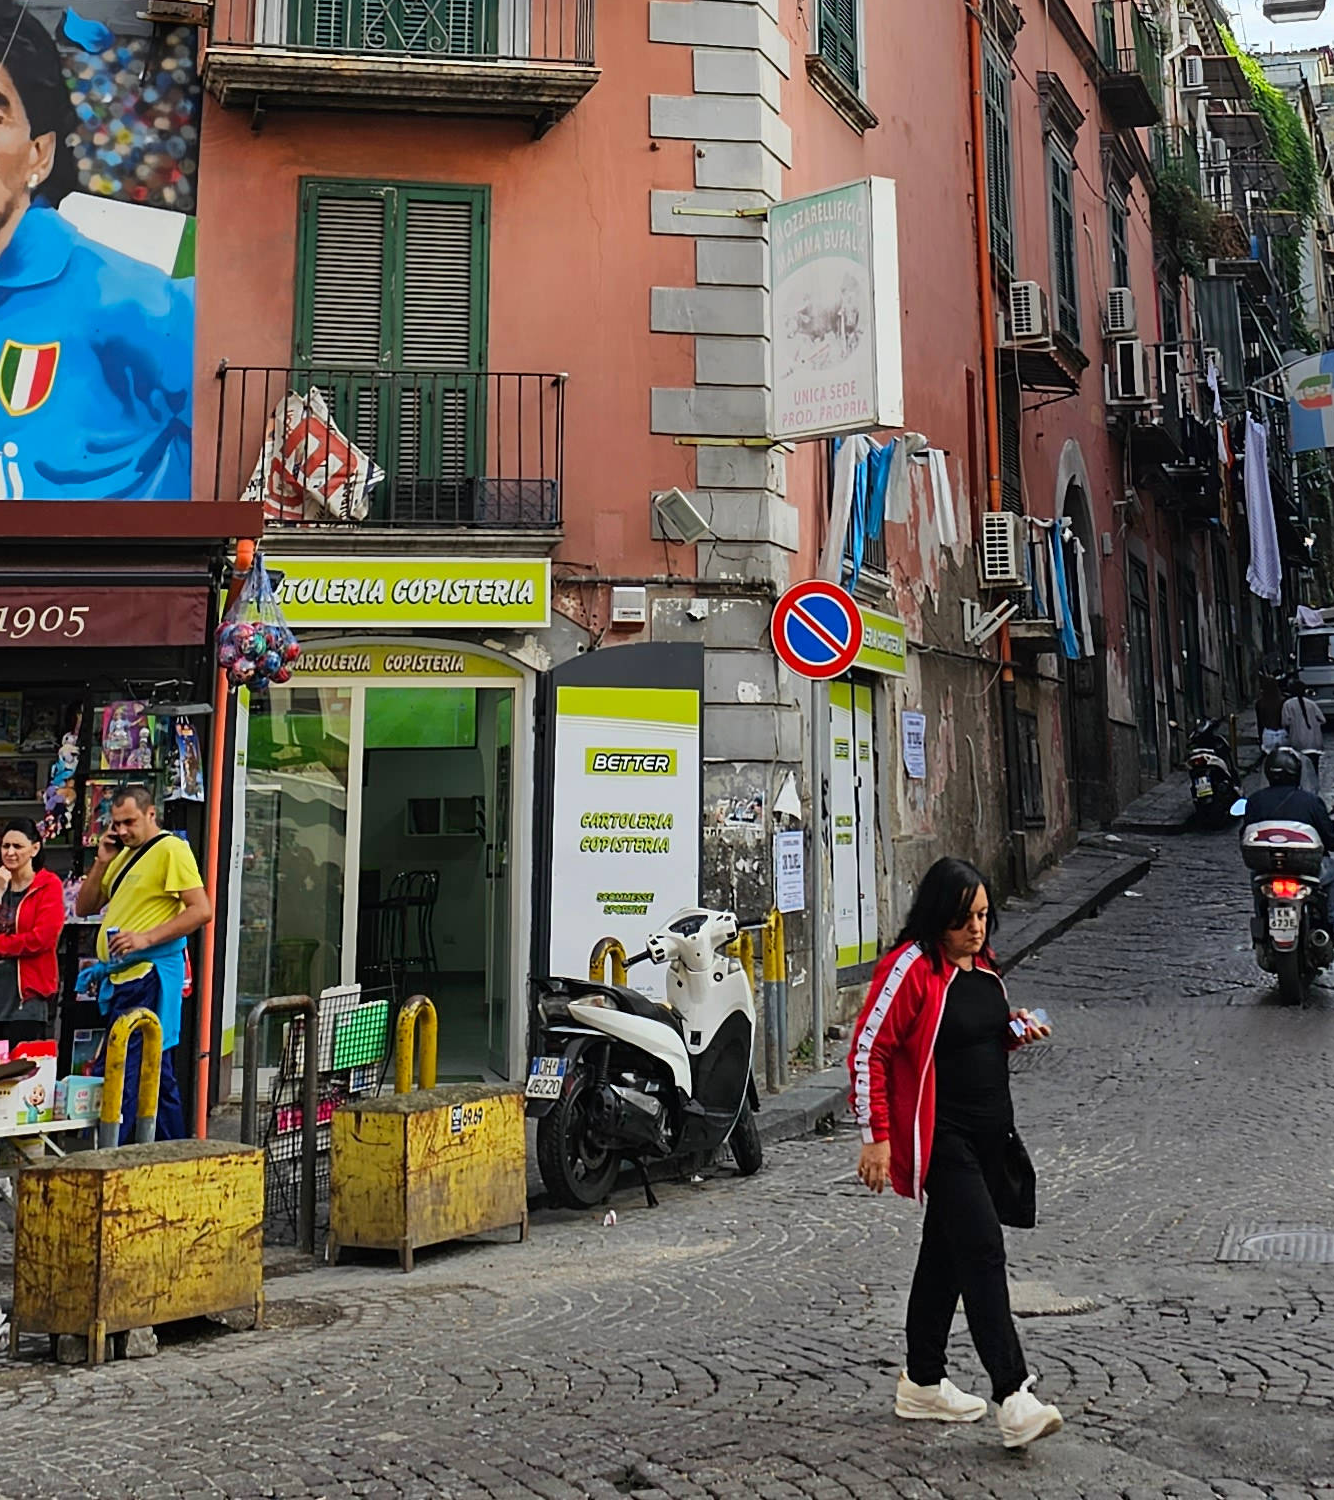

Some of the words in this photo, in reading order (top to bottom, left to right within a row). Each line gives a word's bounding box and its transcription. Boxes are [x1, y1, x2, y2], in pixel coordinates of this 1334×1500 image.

[776, 238, 820, 273] MAMMA
[794, 389, 827, 406] UNICA
[830, 379, 856, 400] SEDE
[782, 409, 817, 427] PROD.
[820, 400, 868, 424] PROPRIA
[592, 754, 670, 773] BETTER
[602, 904, 649, 916] SPORTIVE
